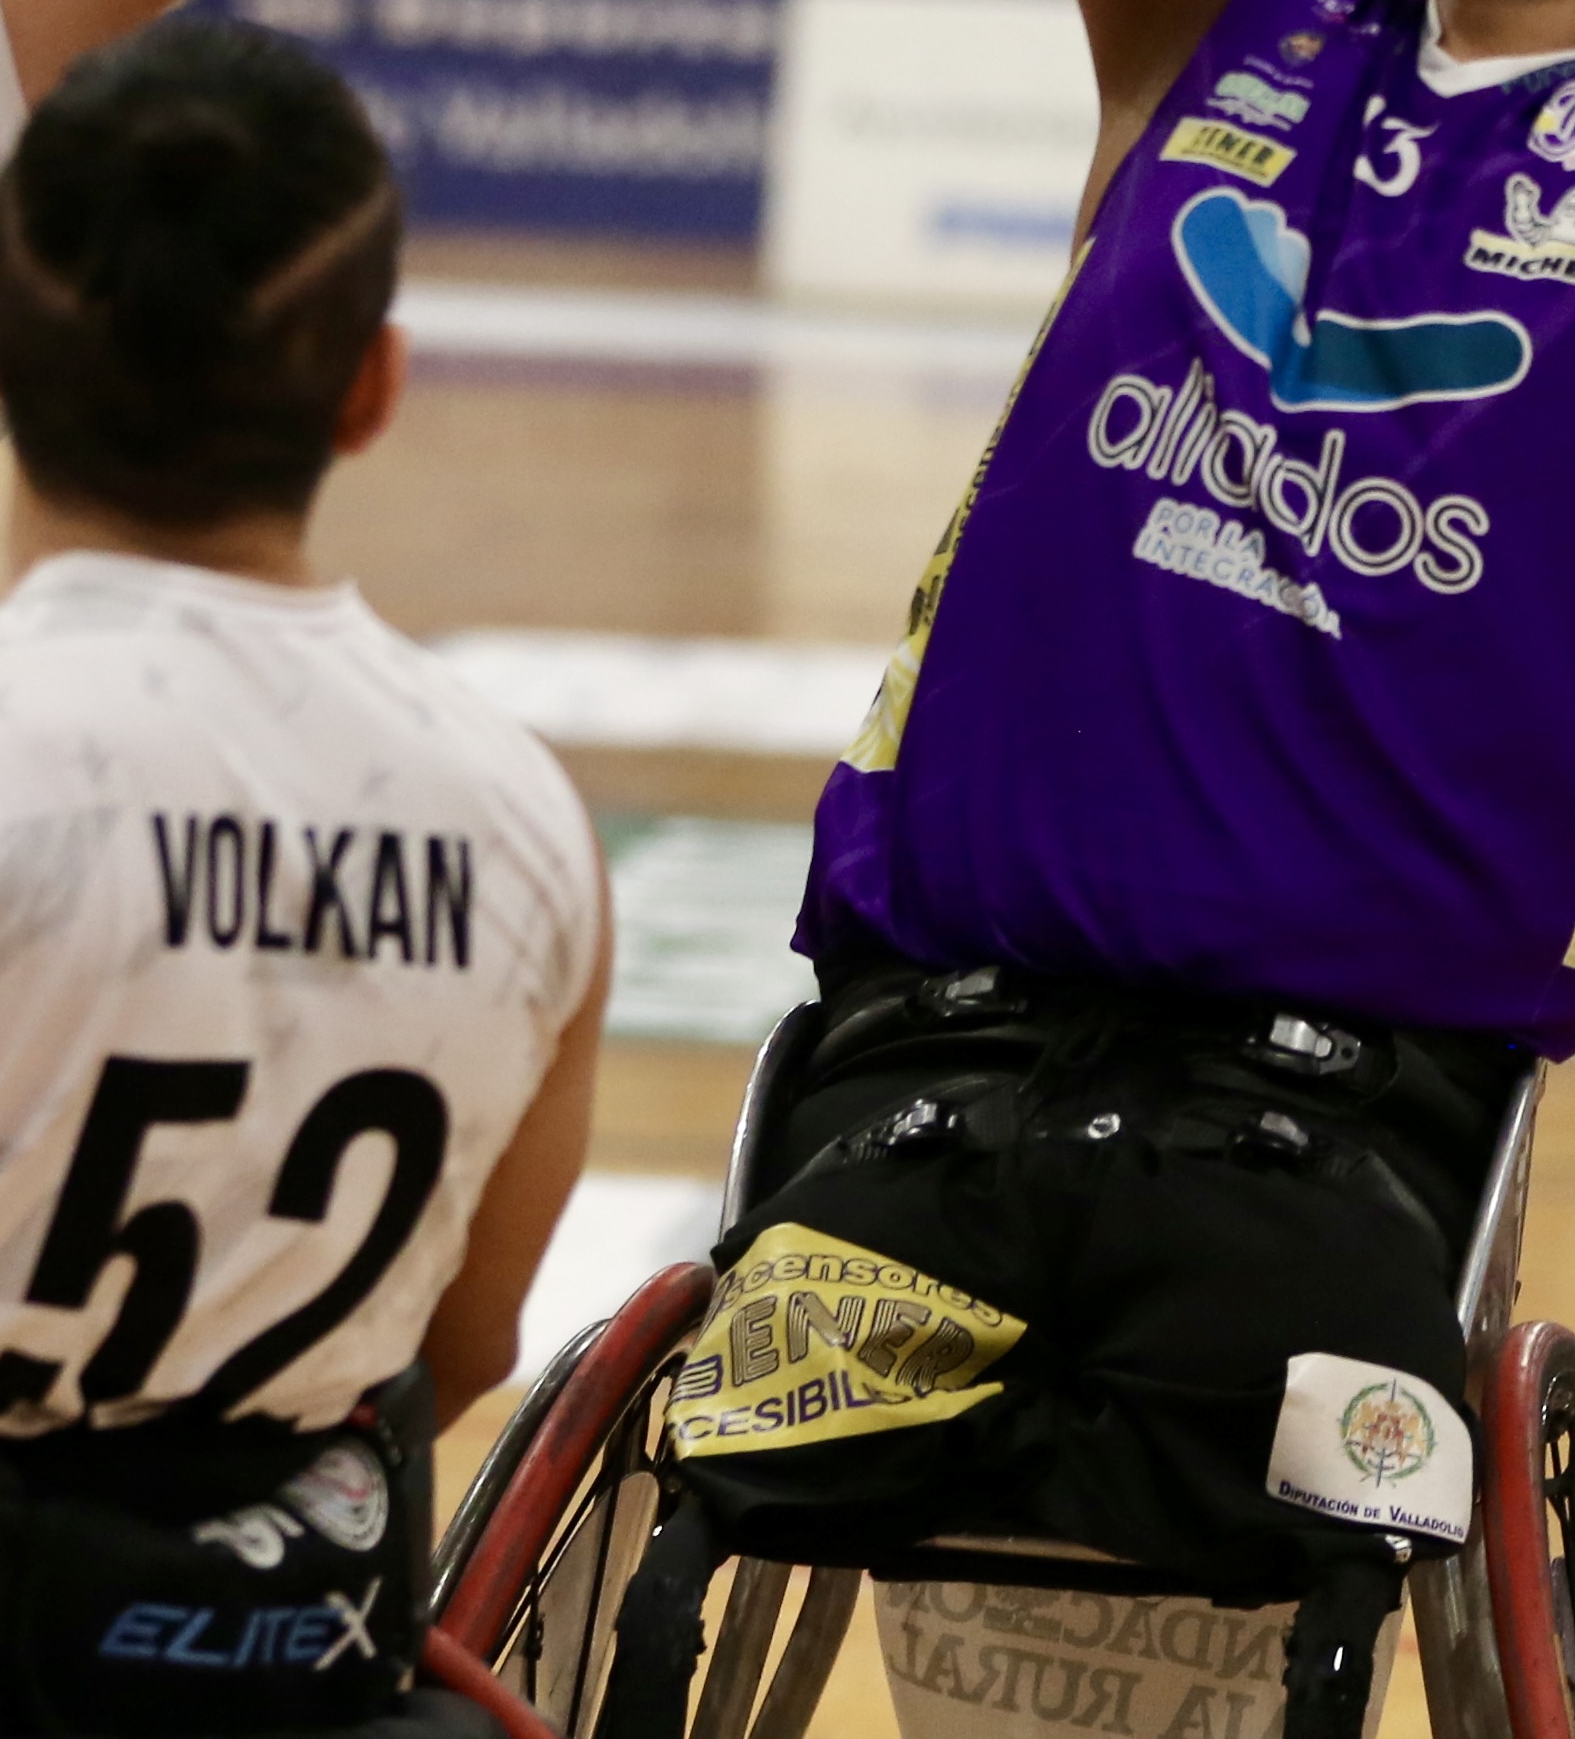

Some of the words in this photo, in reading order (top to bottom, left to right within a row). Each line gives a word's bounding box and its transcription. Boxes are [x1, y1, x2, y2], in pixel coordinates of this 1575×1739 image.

[1088, 357, 1491, 595] aliados
[1154, 501, 1221, 543] POR
[153, 812, 473, 969] VOLKAN
